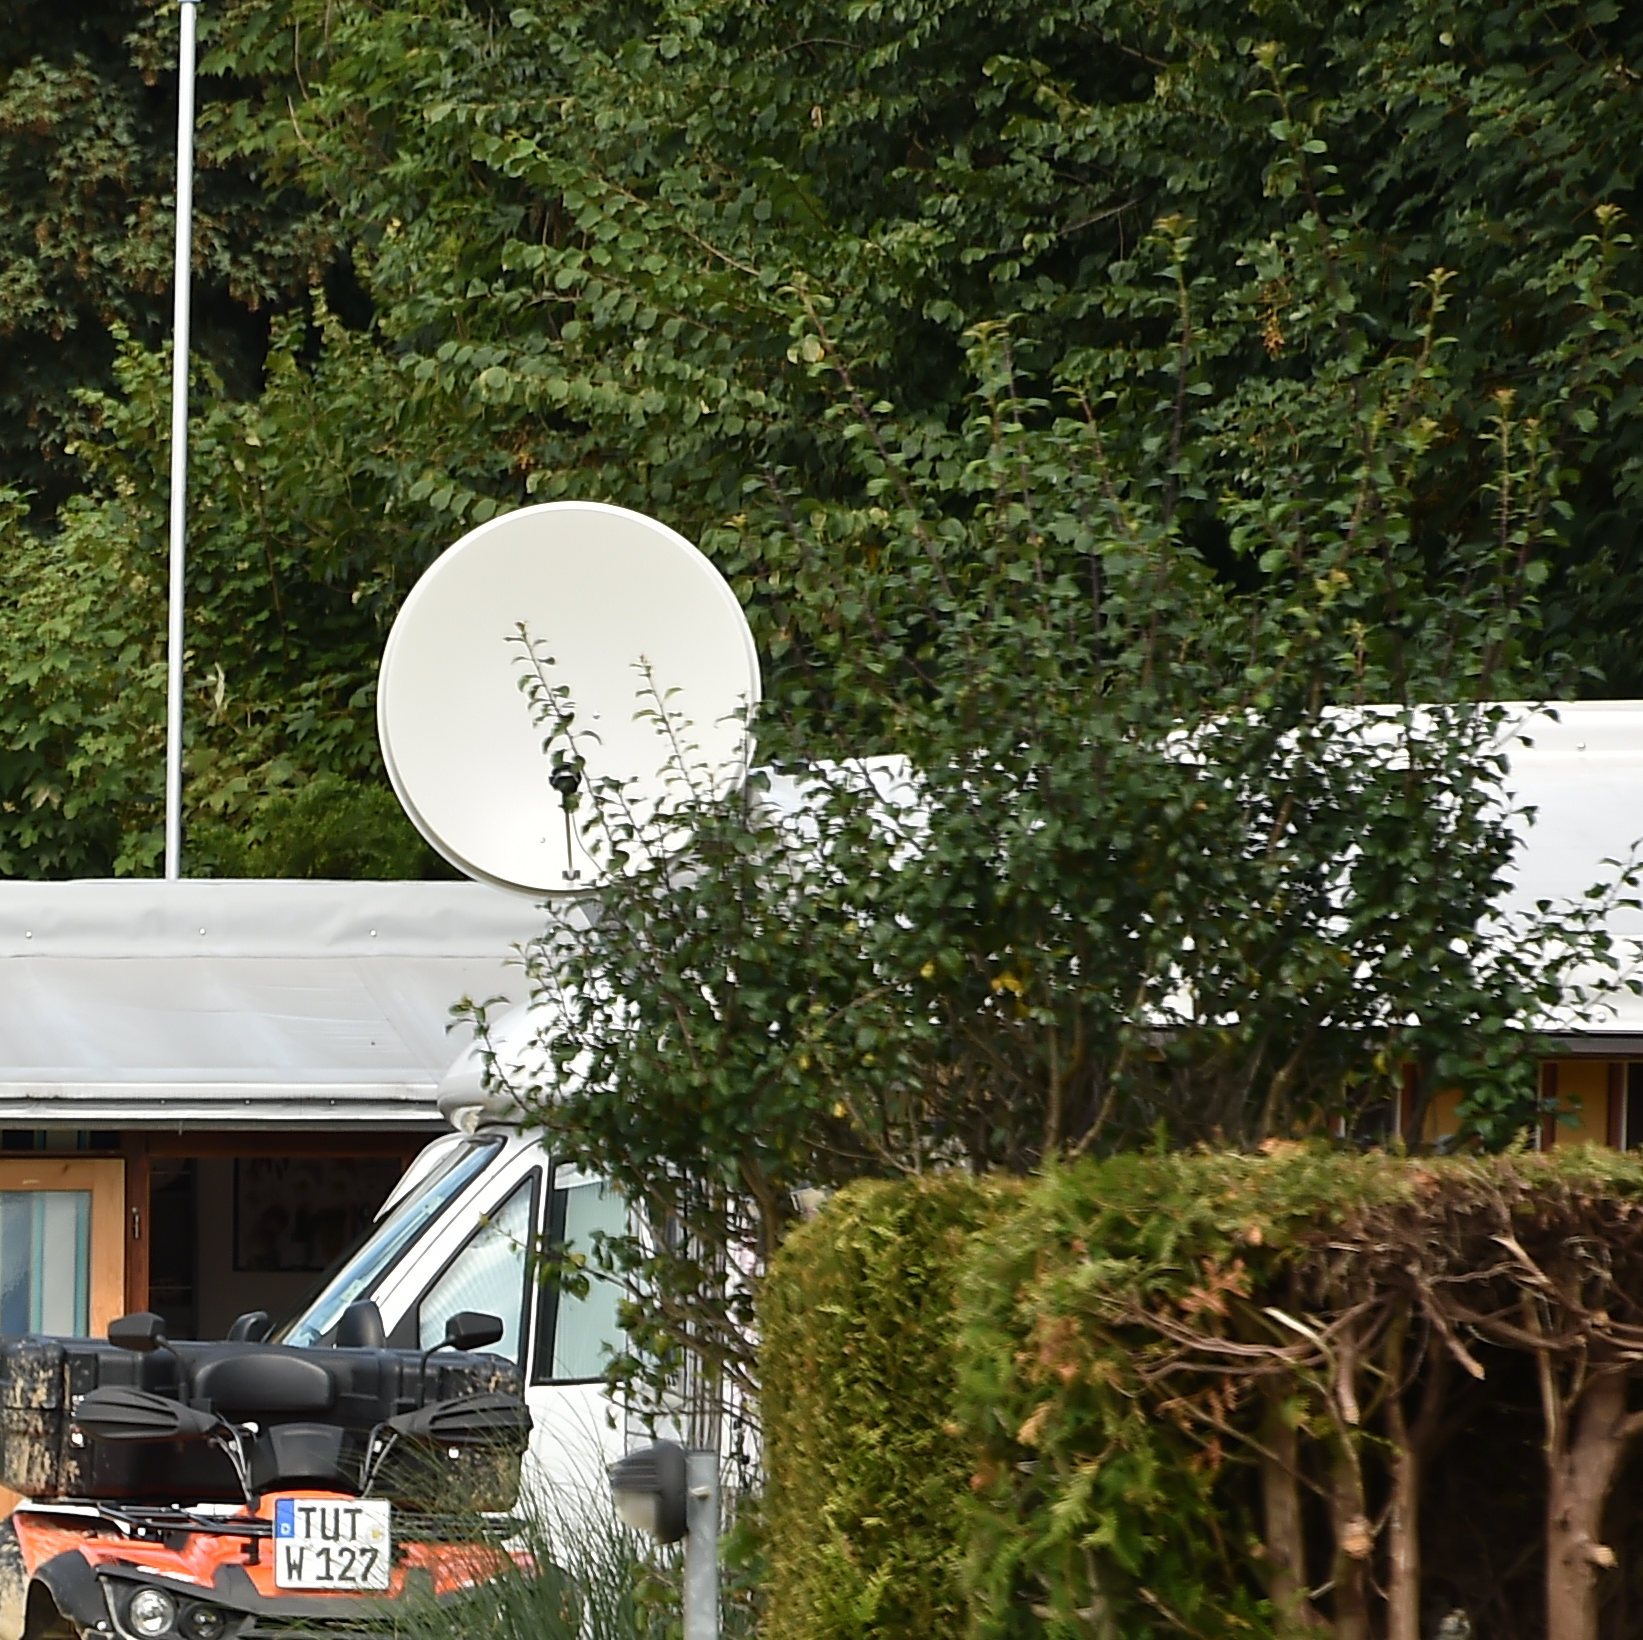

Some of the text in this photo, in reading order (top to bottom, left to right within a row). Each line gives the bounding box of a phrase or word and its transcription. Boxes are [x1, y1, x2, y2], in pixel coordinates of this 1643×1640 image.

[297, 1506, 363, 1541] TUT
[285, 1545, 379, 1582] W 127
